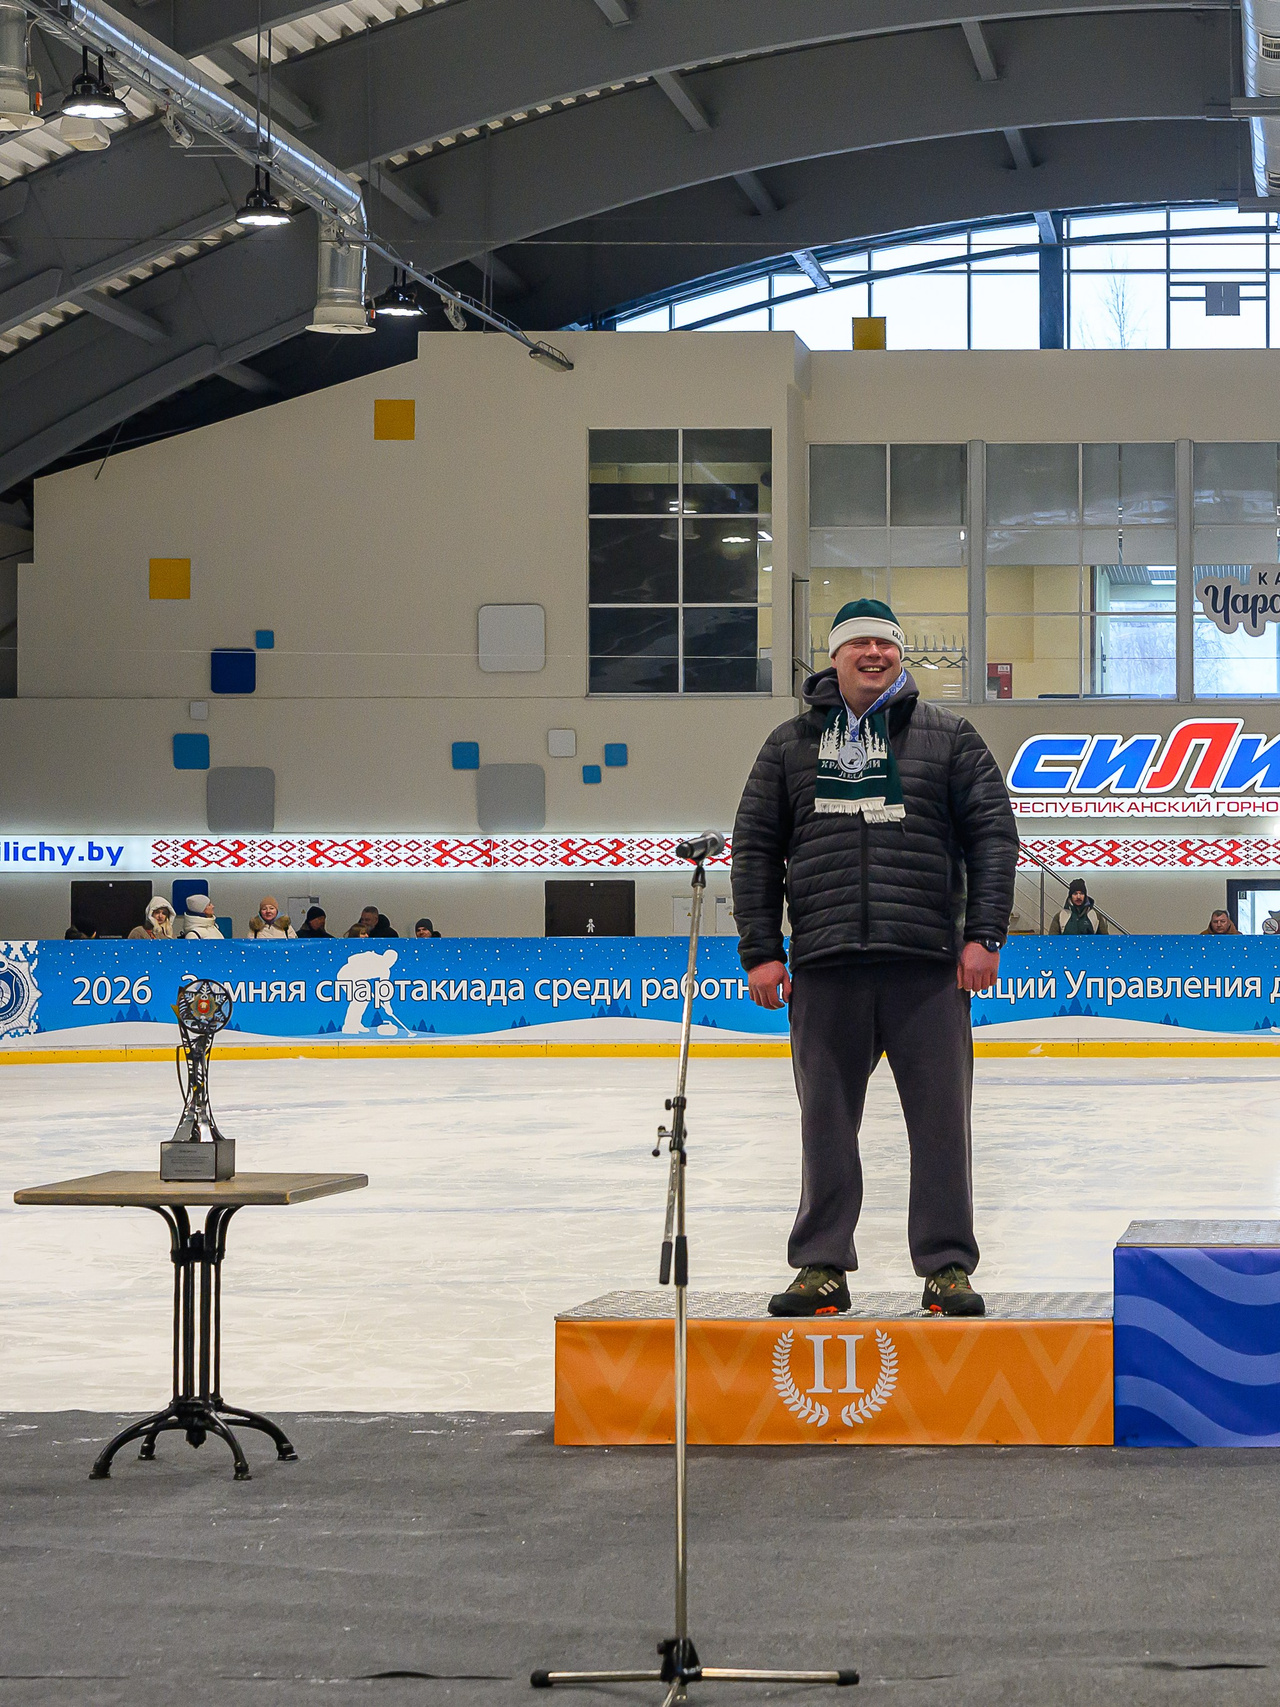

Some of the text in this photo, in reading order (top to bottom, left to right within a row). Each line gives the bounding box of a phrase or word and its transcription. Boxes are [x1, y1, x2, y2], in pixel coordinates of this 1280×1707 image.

[0, 841, 125, 867] lichy.by
[72, 975, 153, 1006] 2026
[315, 978, 525, 1008] спартакиада
[533, 977, 632, 1008] среди
[1064, 970, 1262, 1006] Управления
[804, 1334, 865, 1394] II
